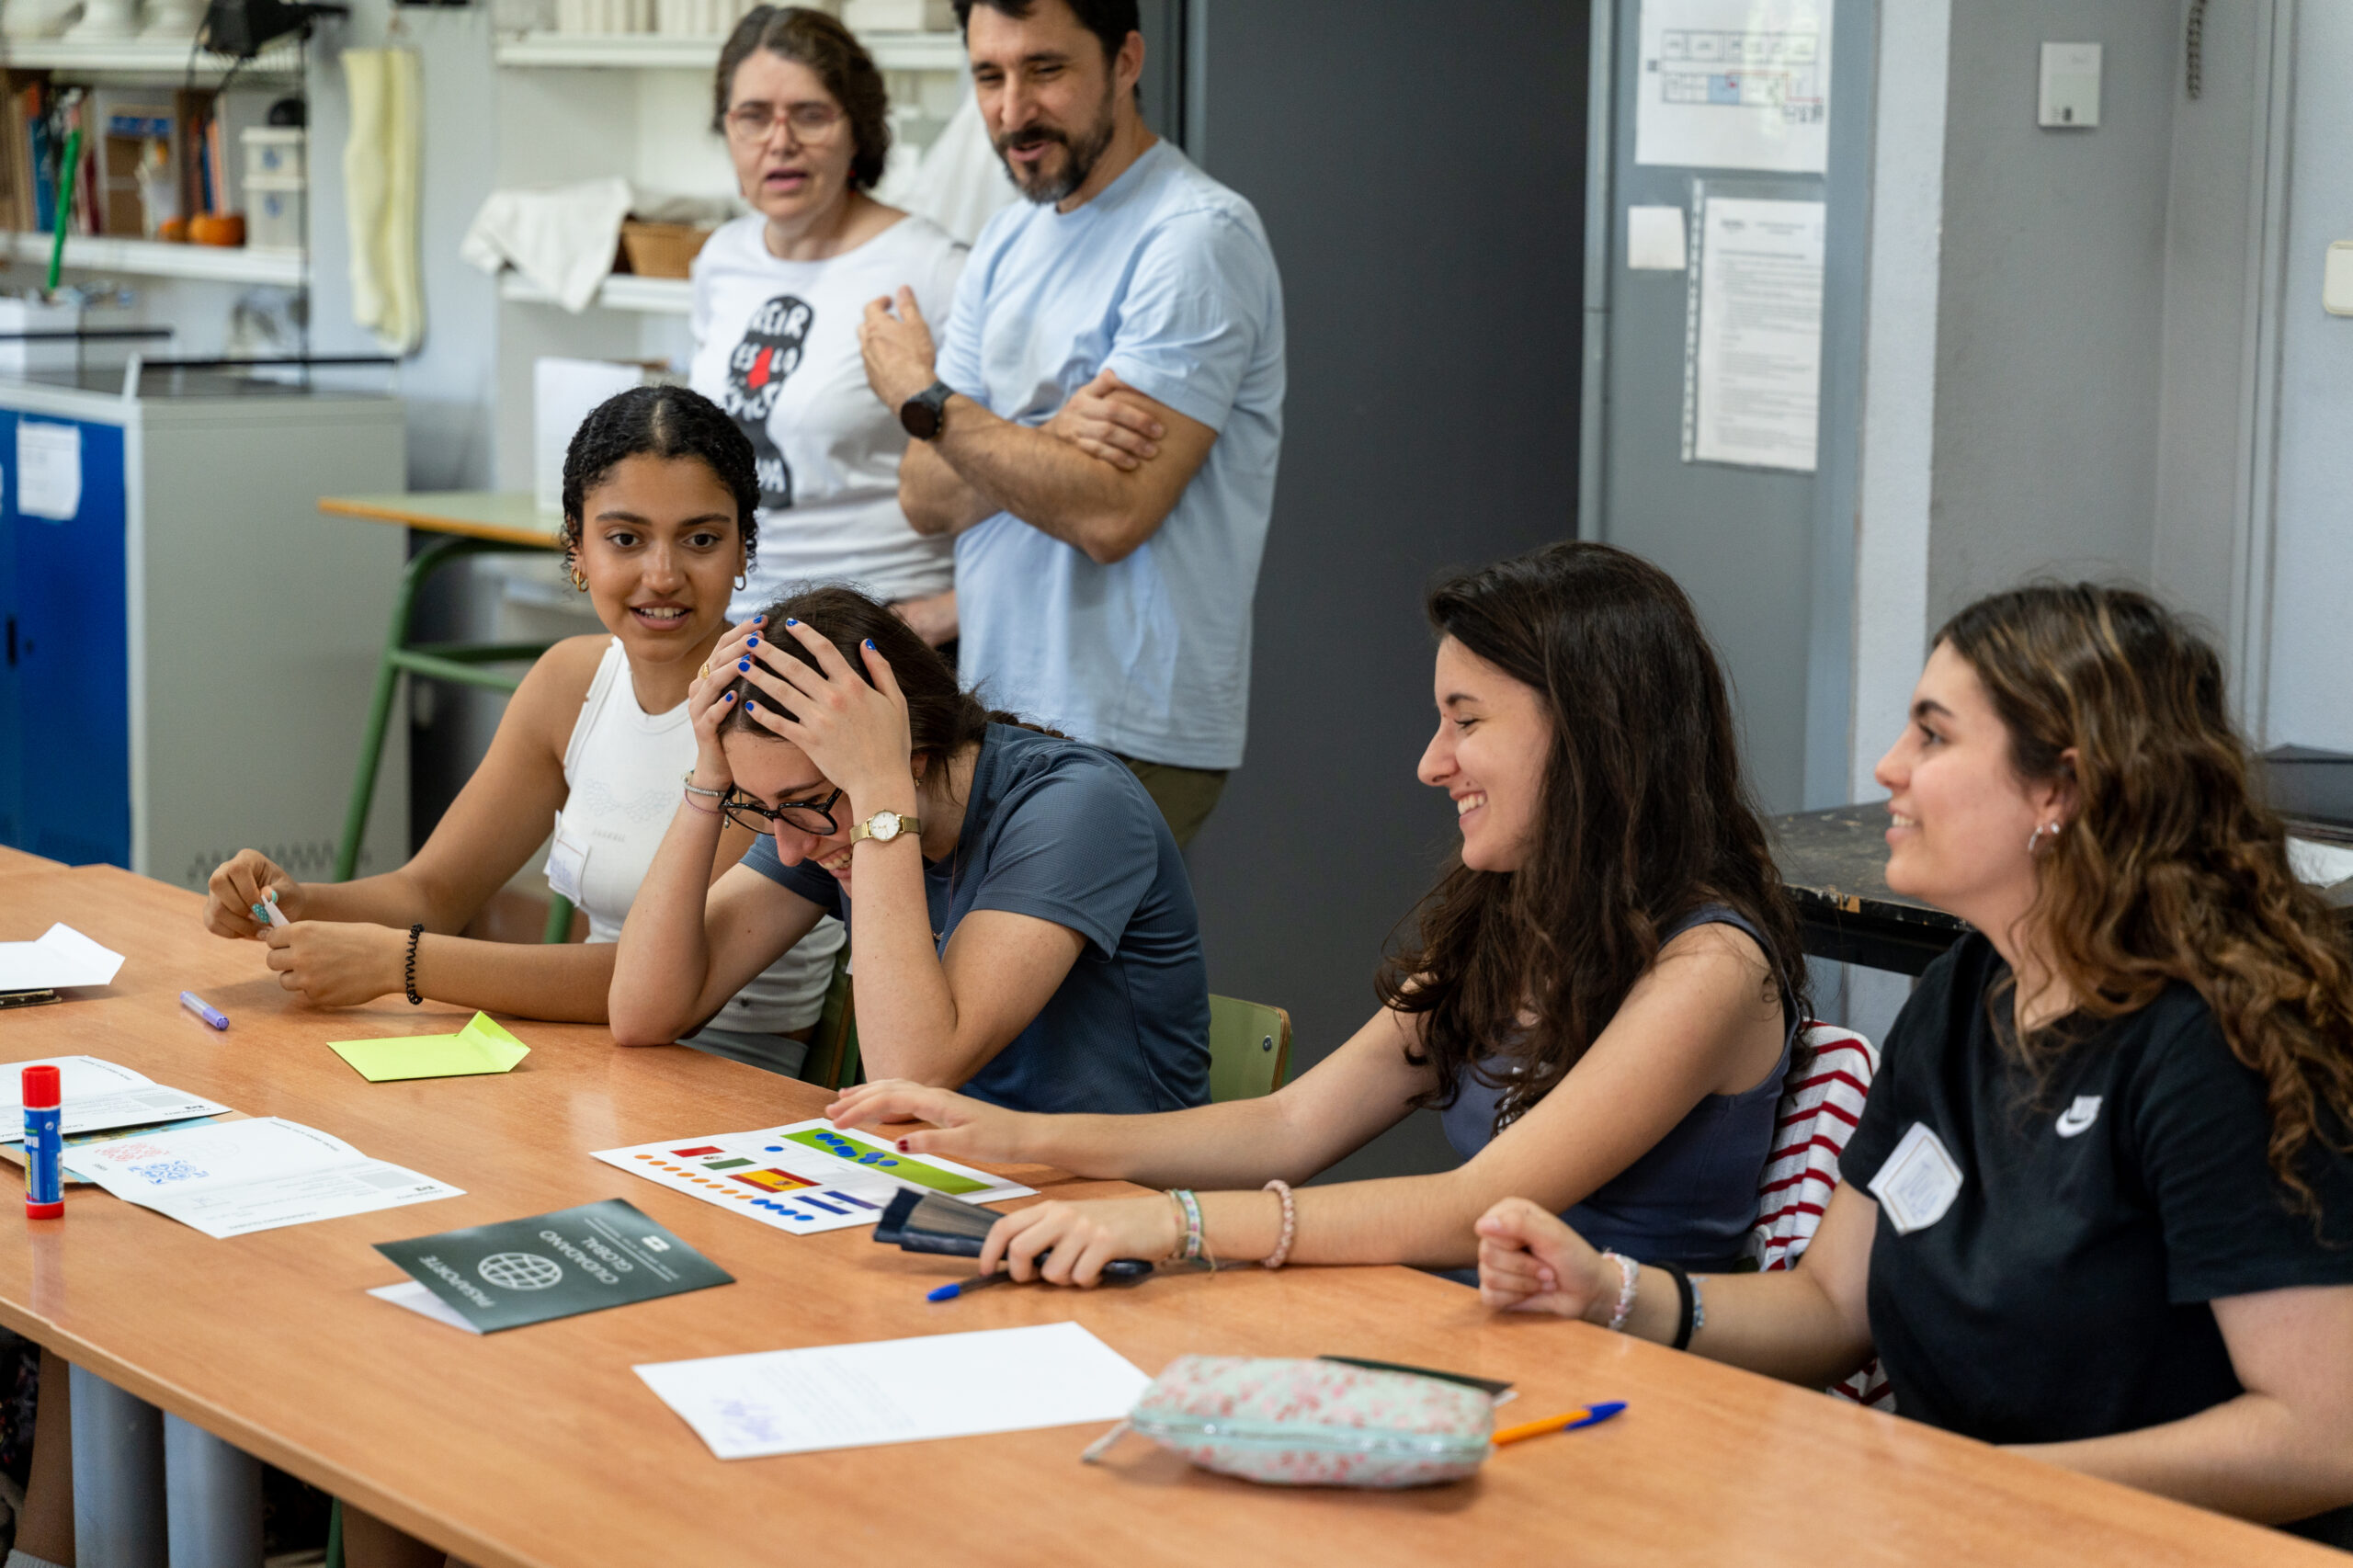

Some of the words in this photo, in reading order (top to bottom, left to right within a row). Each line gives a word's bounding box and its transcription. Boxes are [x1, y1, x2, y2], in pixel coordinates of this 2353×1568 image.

[539, 1230, 620, 1285] CIUDADANO
[581, 1235, 634, 1273] GLOBAL
[419, 1256, 495, 1308] PASAPORTE
